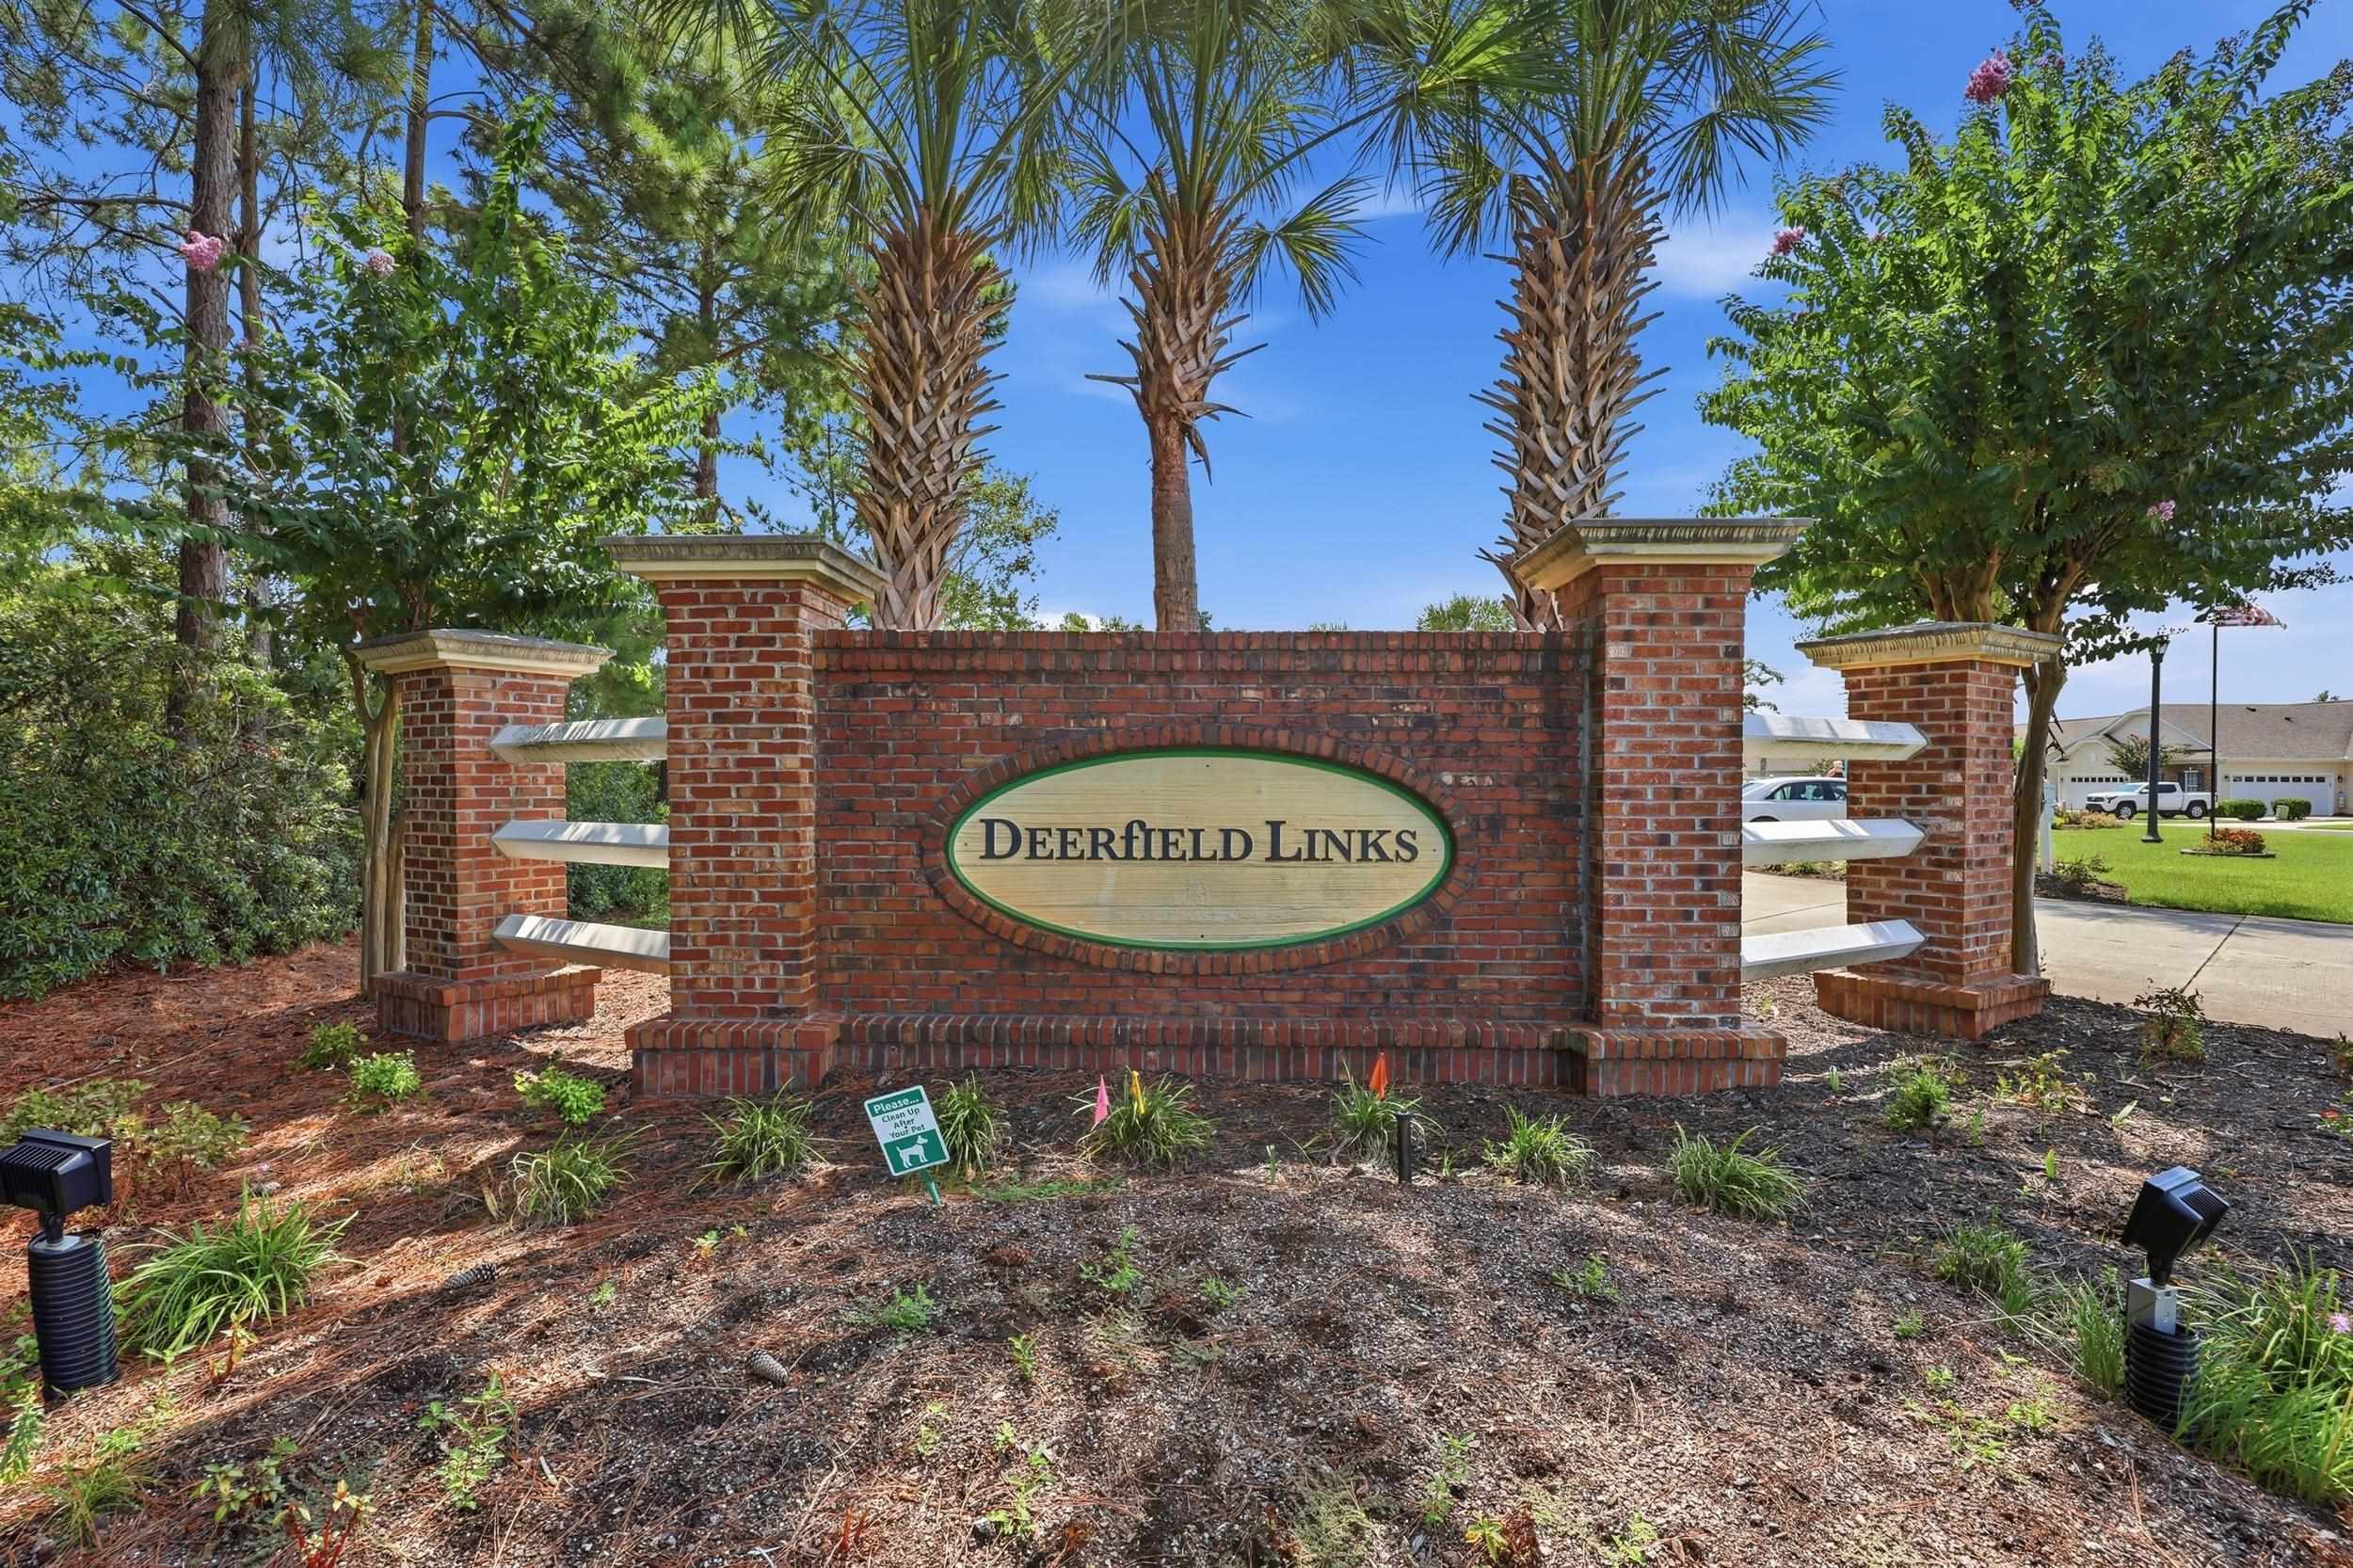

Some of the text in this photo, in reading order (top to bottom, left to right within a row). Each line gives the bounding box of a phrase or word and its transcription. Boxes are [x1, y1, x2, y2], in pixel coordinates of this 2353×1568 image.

[1265, 820, 1419, 862] LINKS
[872, 1098, 920, 1114] Please...
[881, 1108, 920, 1123] Clean Up
[893, 1118, 915, 1129] After
[889, 1124, 926, 1139] Your Pet
